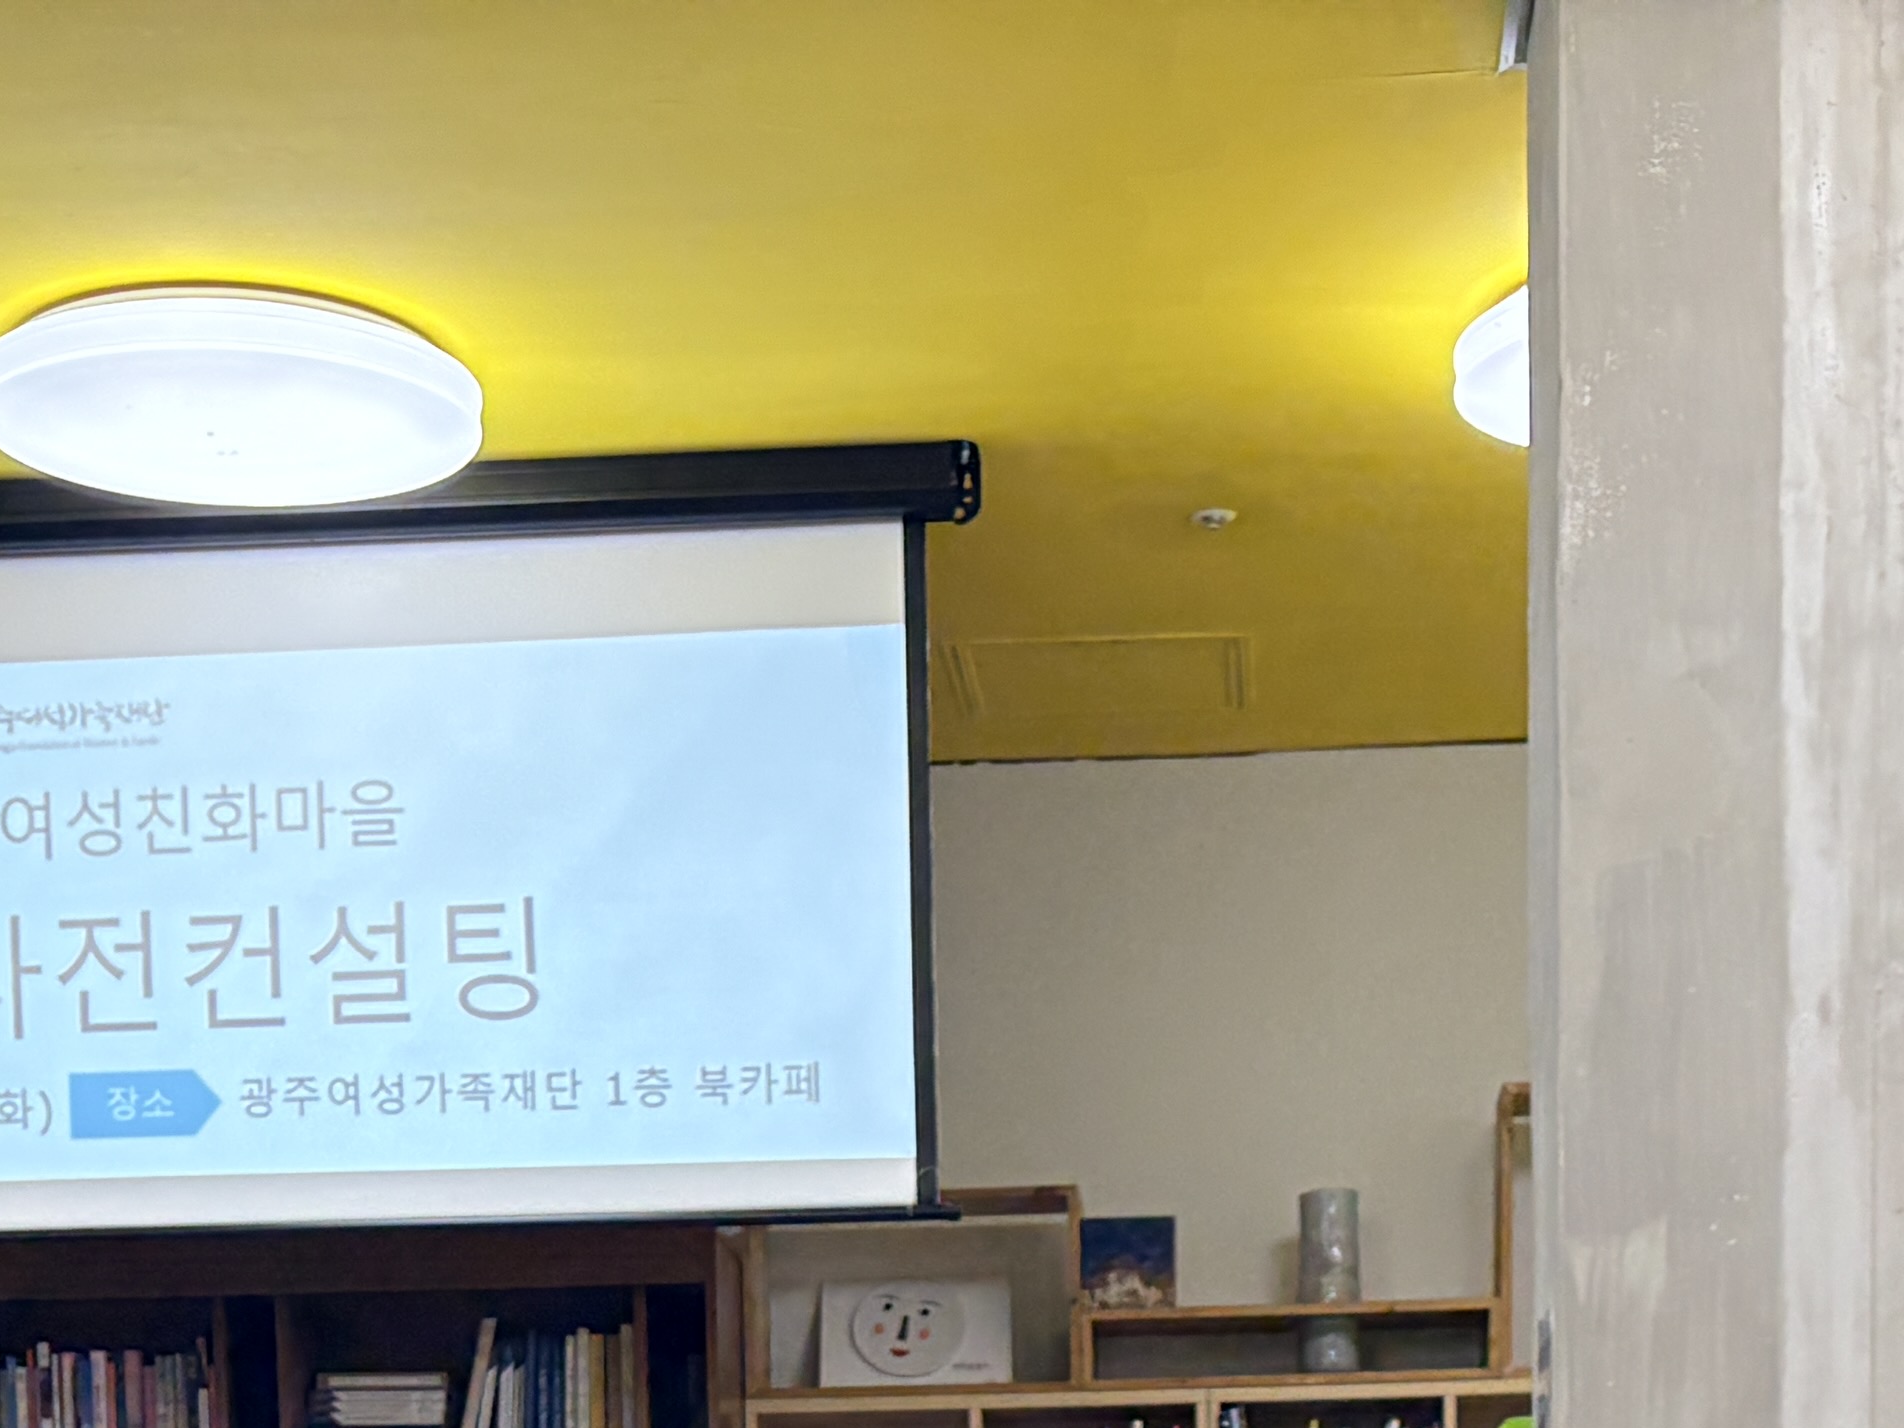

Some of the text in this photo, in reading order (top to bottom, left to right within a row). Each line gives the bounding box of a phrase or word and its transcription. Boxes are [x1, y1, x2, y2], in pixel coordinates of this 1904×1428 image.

[0, 778, 405, 860] 여성친화마을
[106, 1084, 177, 1123] 장소
[239, 1059, 823, 1119] 광주여성가족재단 1층 북카페
